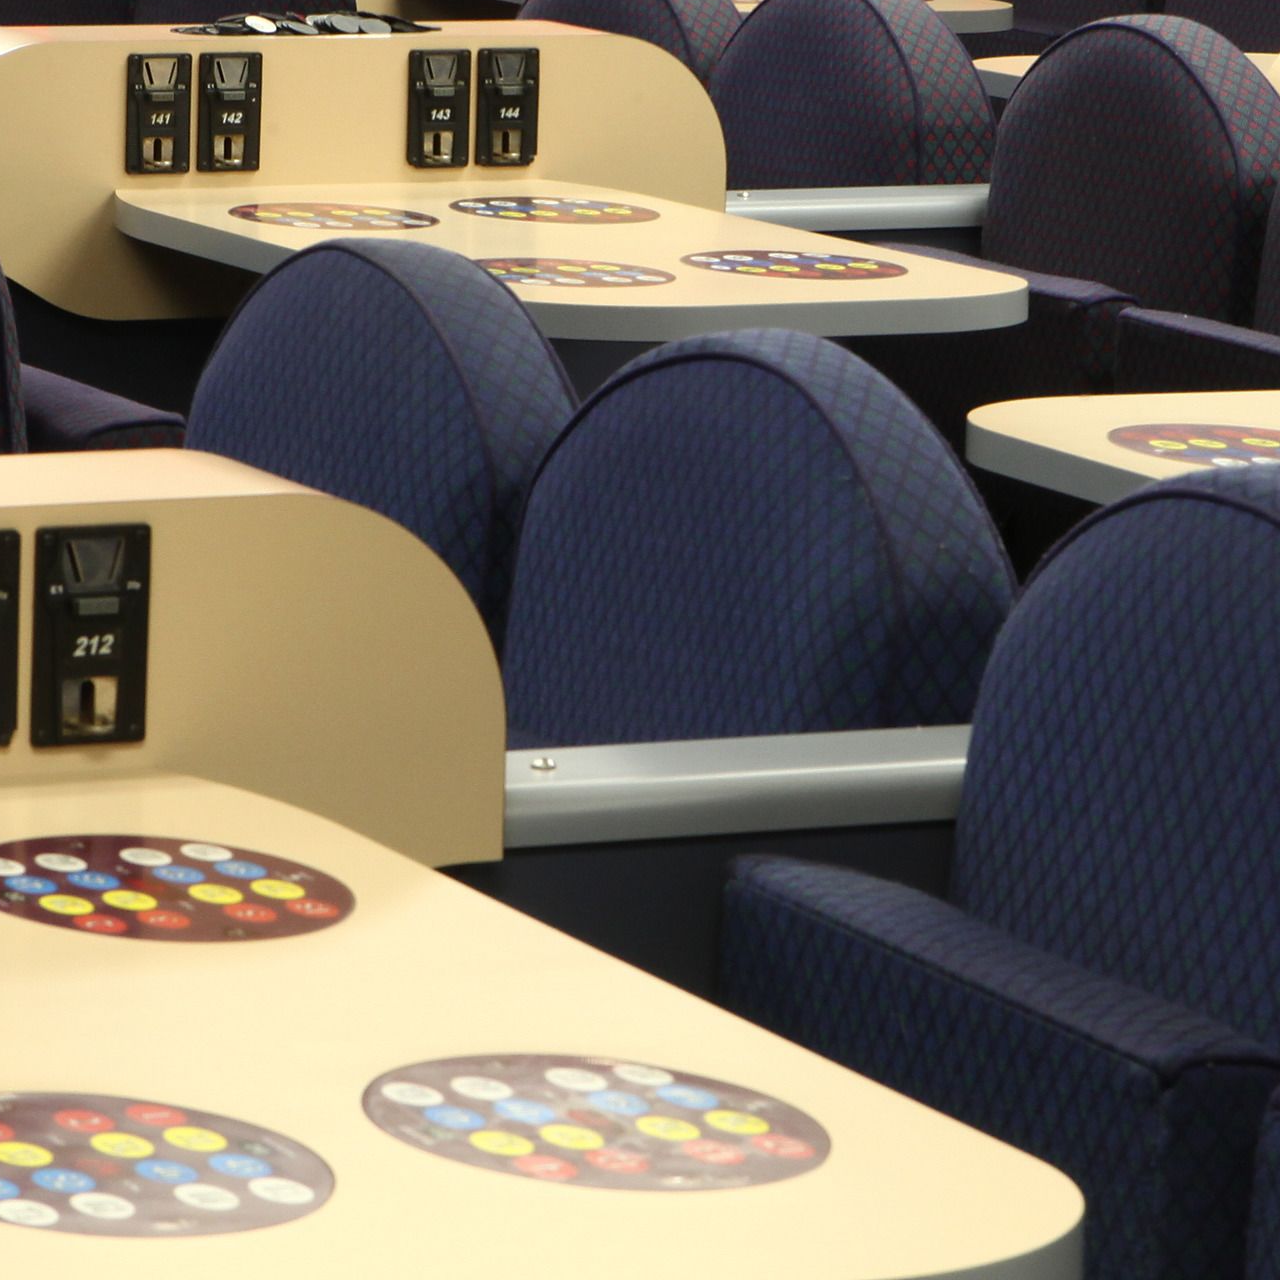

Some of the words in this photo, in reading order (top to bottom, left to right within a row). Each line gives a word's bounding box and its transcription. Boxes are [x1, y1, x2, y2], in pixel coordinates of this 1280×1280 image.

[149, 112, 171, 126] 141
[221, 112, 243, 125] 142
[430, 108, 451, 121] 143
[499, 107, 520, 119] 144
[73, 634, 114, 657] 212
